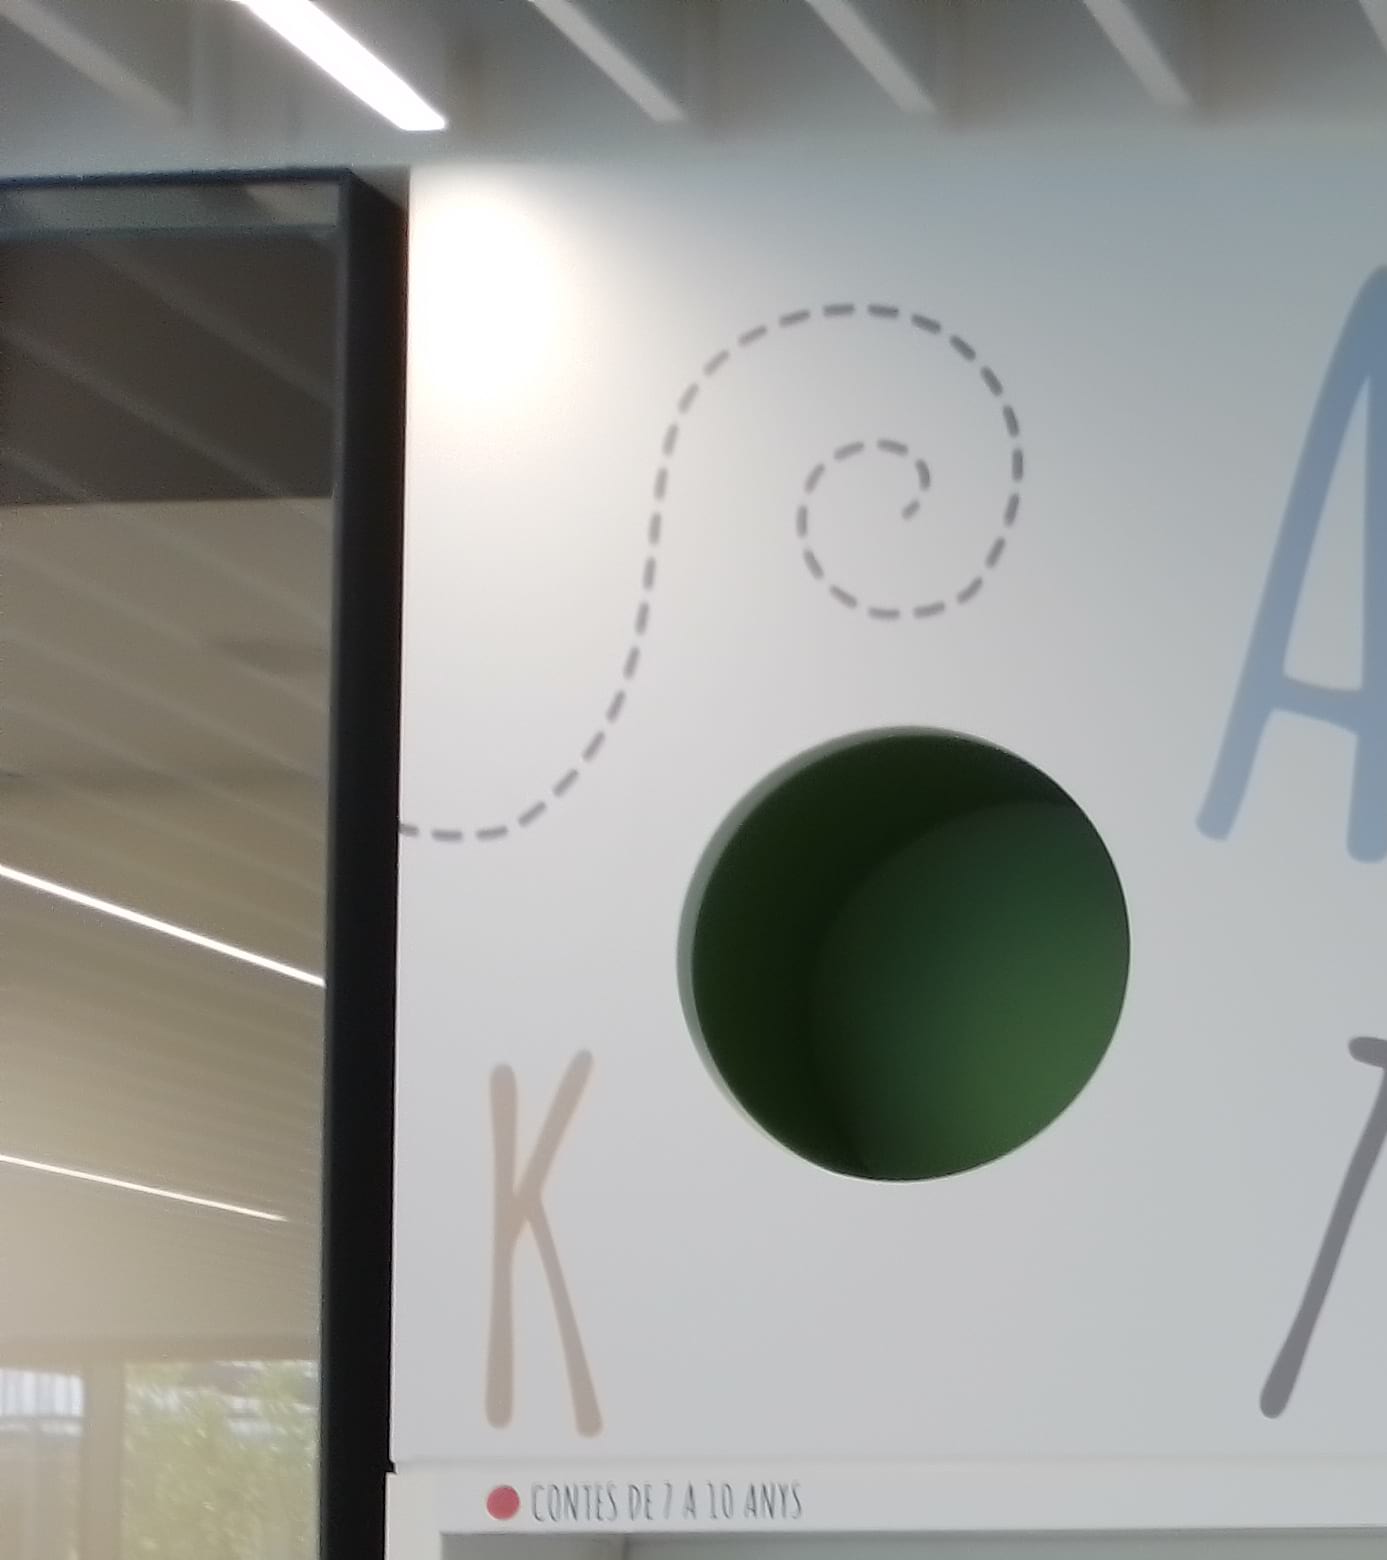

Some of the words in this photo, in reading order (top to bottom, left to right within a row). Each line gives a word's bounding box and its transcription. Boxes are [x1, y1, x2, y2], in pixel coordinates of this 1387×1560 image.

[484, 1049, 603, 1437] K
[530, 1482, 618, 1522] CONTES
[628, 1483, 654, 1521] DE
[682, 1481, 698, 1520] A
[707, 1482, 734, 1520] 10
[744, 1480, 802, 1520] ANYS
